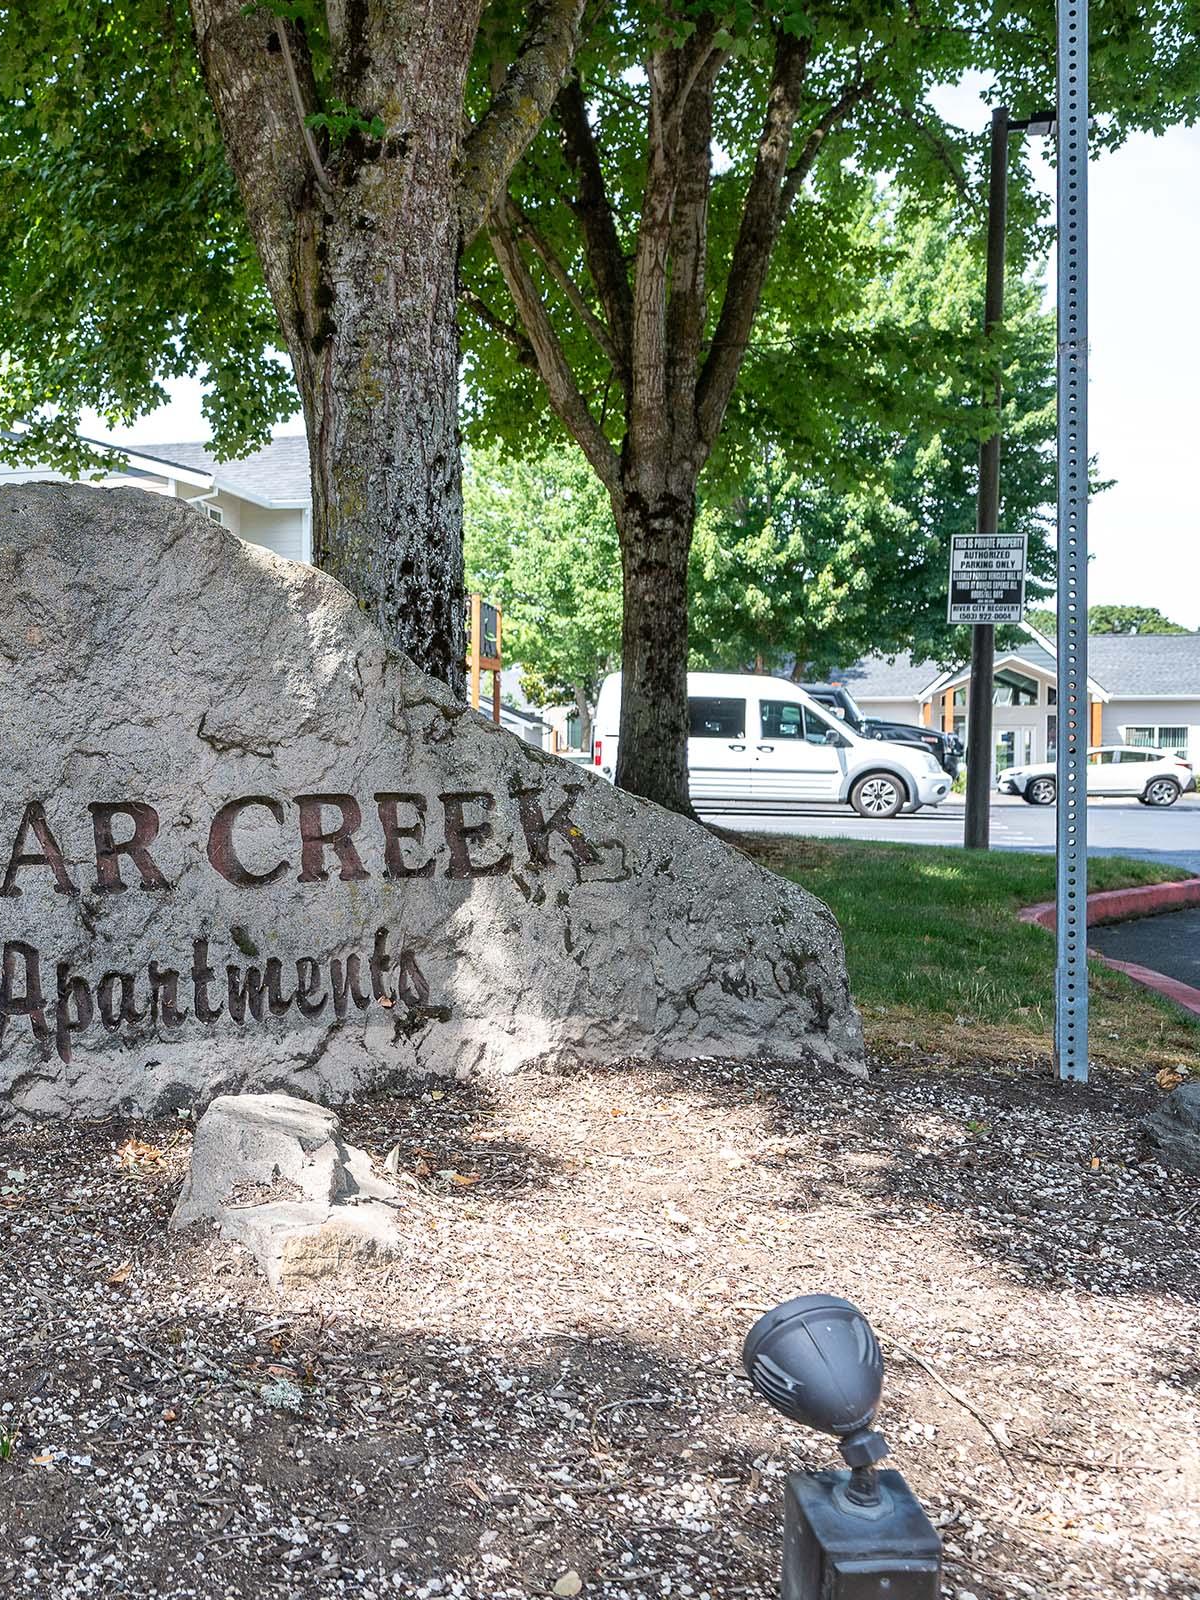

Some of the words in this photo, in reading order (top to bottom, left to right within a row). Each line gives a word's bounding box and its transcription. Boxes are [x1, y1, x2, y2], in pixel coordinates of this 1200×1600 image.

[964, 550, 1010, 559] AUTHORIZED
[960, 560, 994, 569] PARKING
[996, 560, 1016, 569] ONLY
[987, 604, 1019, 612] RECOVERY
[207, 784, 602, 888] CREEK
